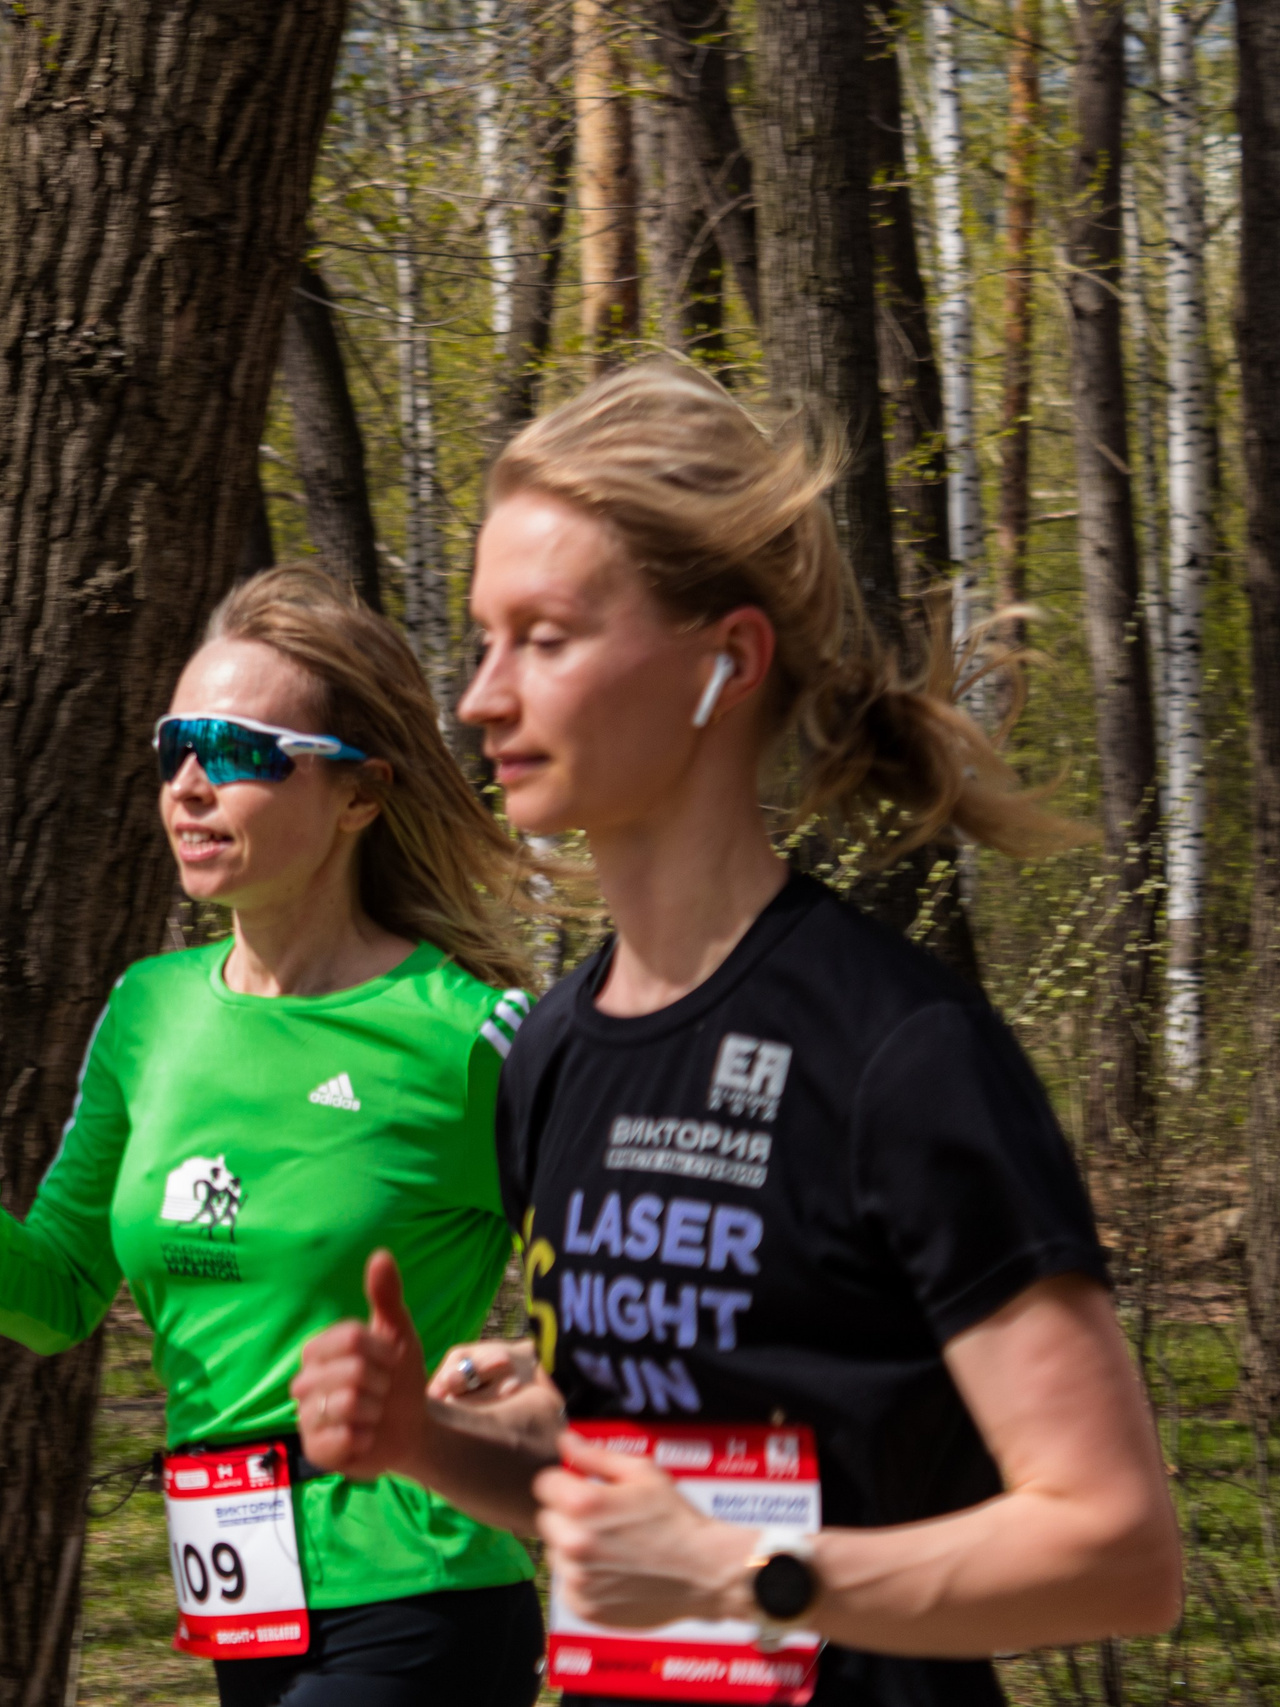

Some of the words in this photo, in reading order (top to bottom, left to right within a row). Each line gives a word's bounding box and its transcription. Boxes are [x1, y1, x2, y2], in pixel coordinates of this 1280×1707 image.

[308, 1091, 361, 1112] adidas
[609, 1115, 773, 1164] ВИКТОРИЯ
[564, 1189, 764, 1275] LASER
[560, 1270, 753, 1351] NIGHT
